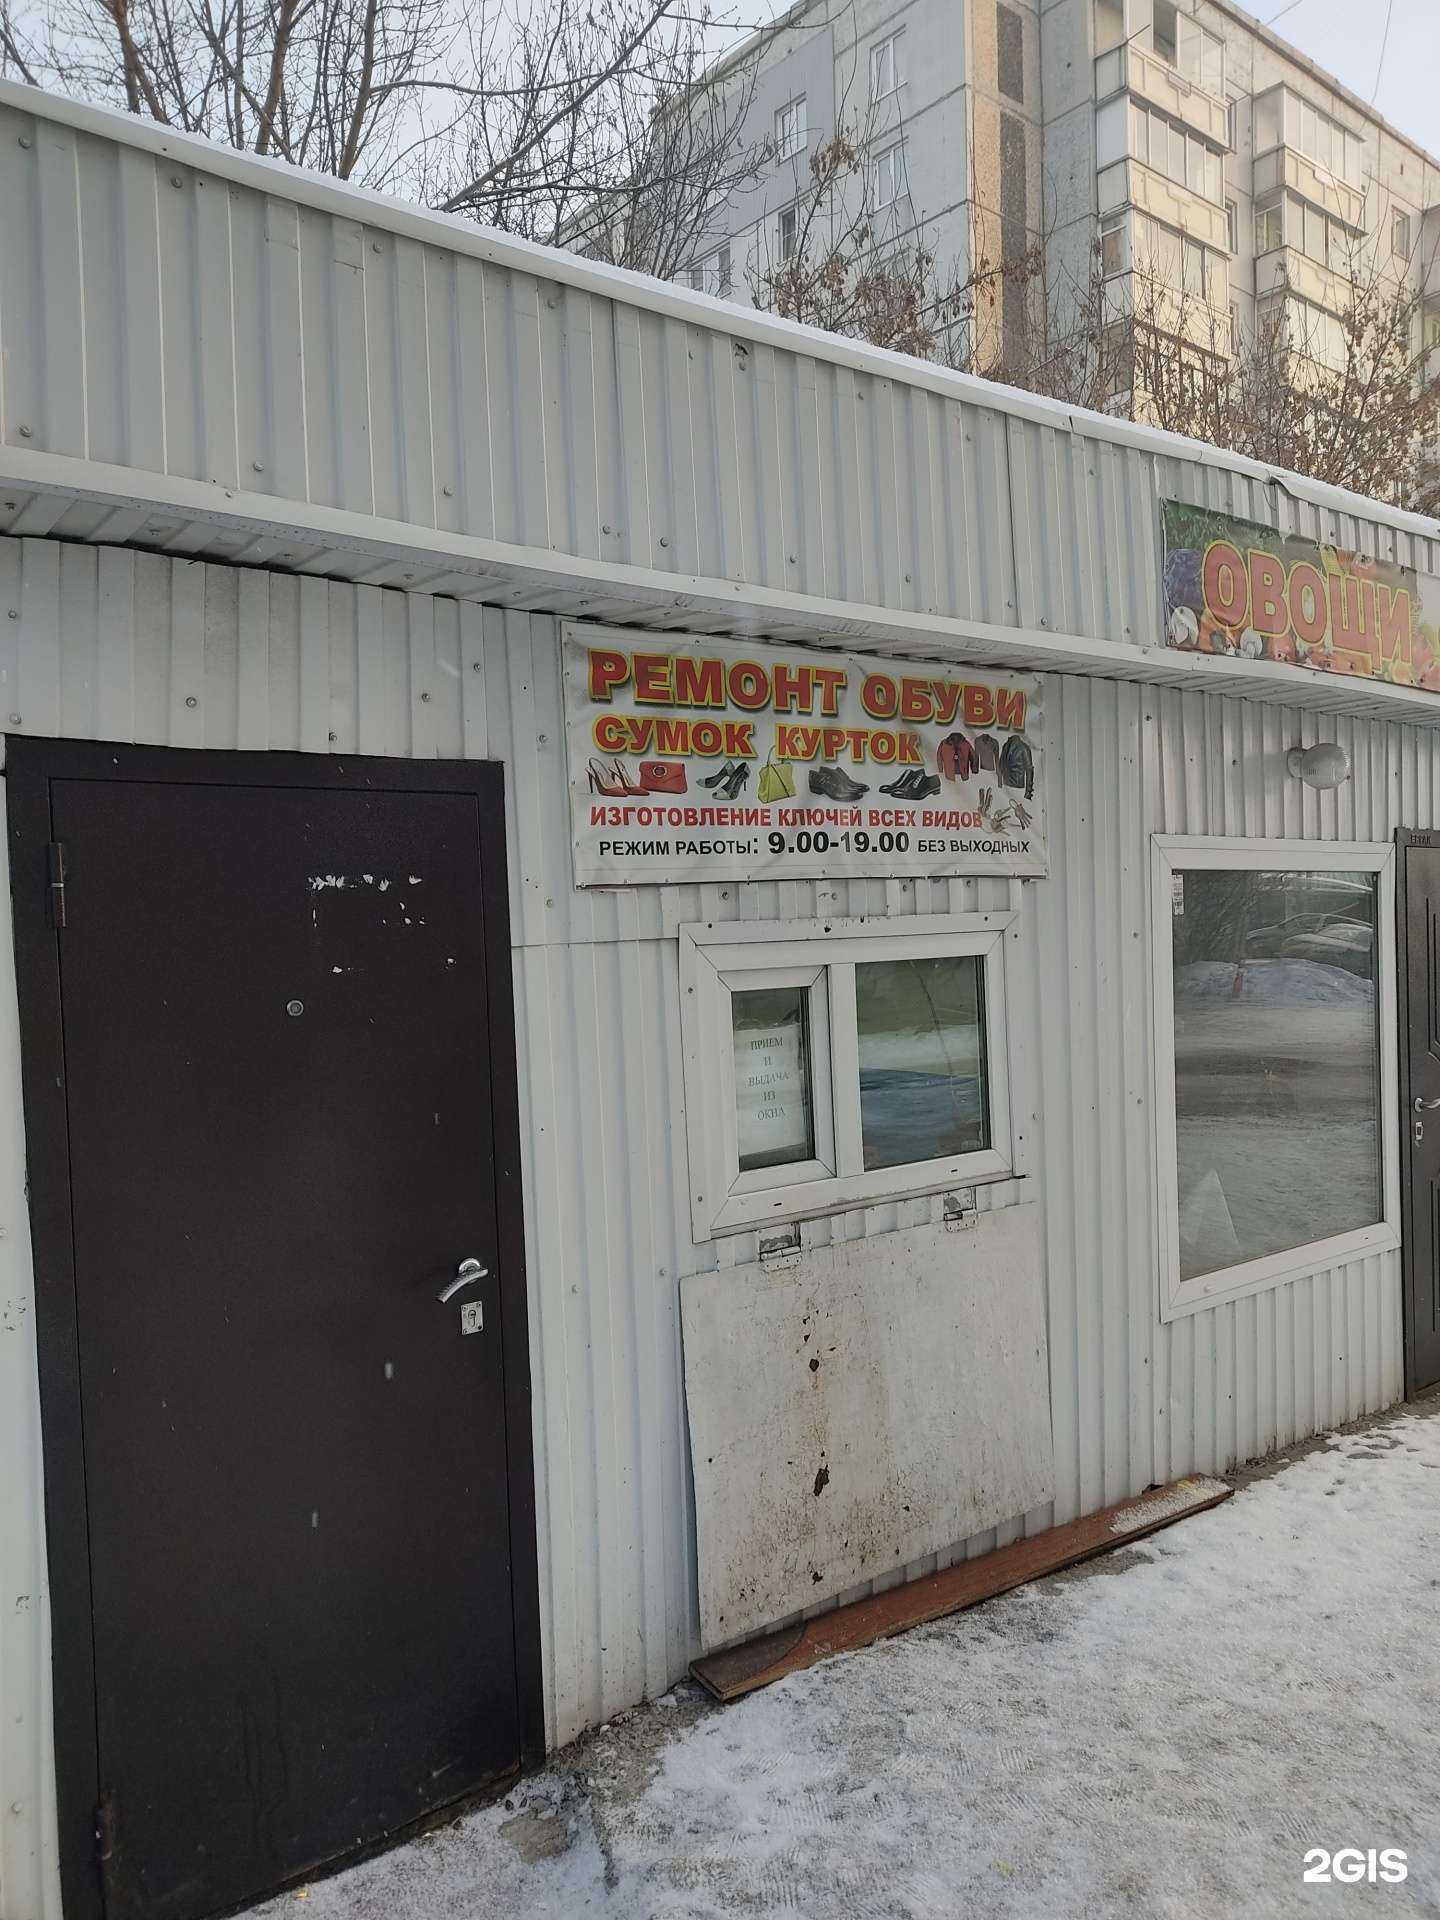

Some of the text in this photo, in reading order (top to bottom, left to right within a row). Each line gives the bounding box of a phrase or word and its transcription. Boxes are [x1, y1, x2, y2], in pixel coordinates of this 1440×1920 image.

[1202, 540, 1411, 673] ОВОЩИ
[587, 648, 1027, 729] РЕМОНТ ОБУВИ
[592, 714, 924, 764] СУМОК КУРТОК
[590, 805, 983, 831] ИЗГОТОВЛЕНИЕ КЛЮЧЕЙ ВСЕХ ВИДОВ
[599, 831, 1030, 856] РЕЖИМ РАБОТЫ: 9.00-19.00 БЕЗ ВЫХОДНЫХ
[751, 1037, 784, 1050] ПРИЕМ
[748, 1071, 790, 1087] ВЫДАЧА
[757, 1106, 786, 1121] ОКНА
